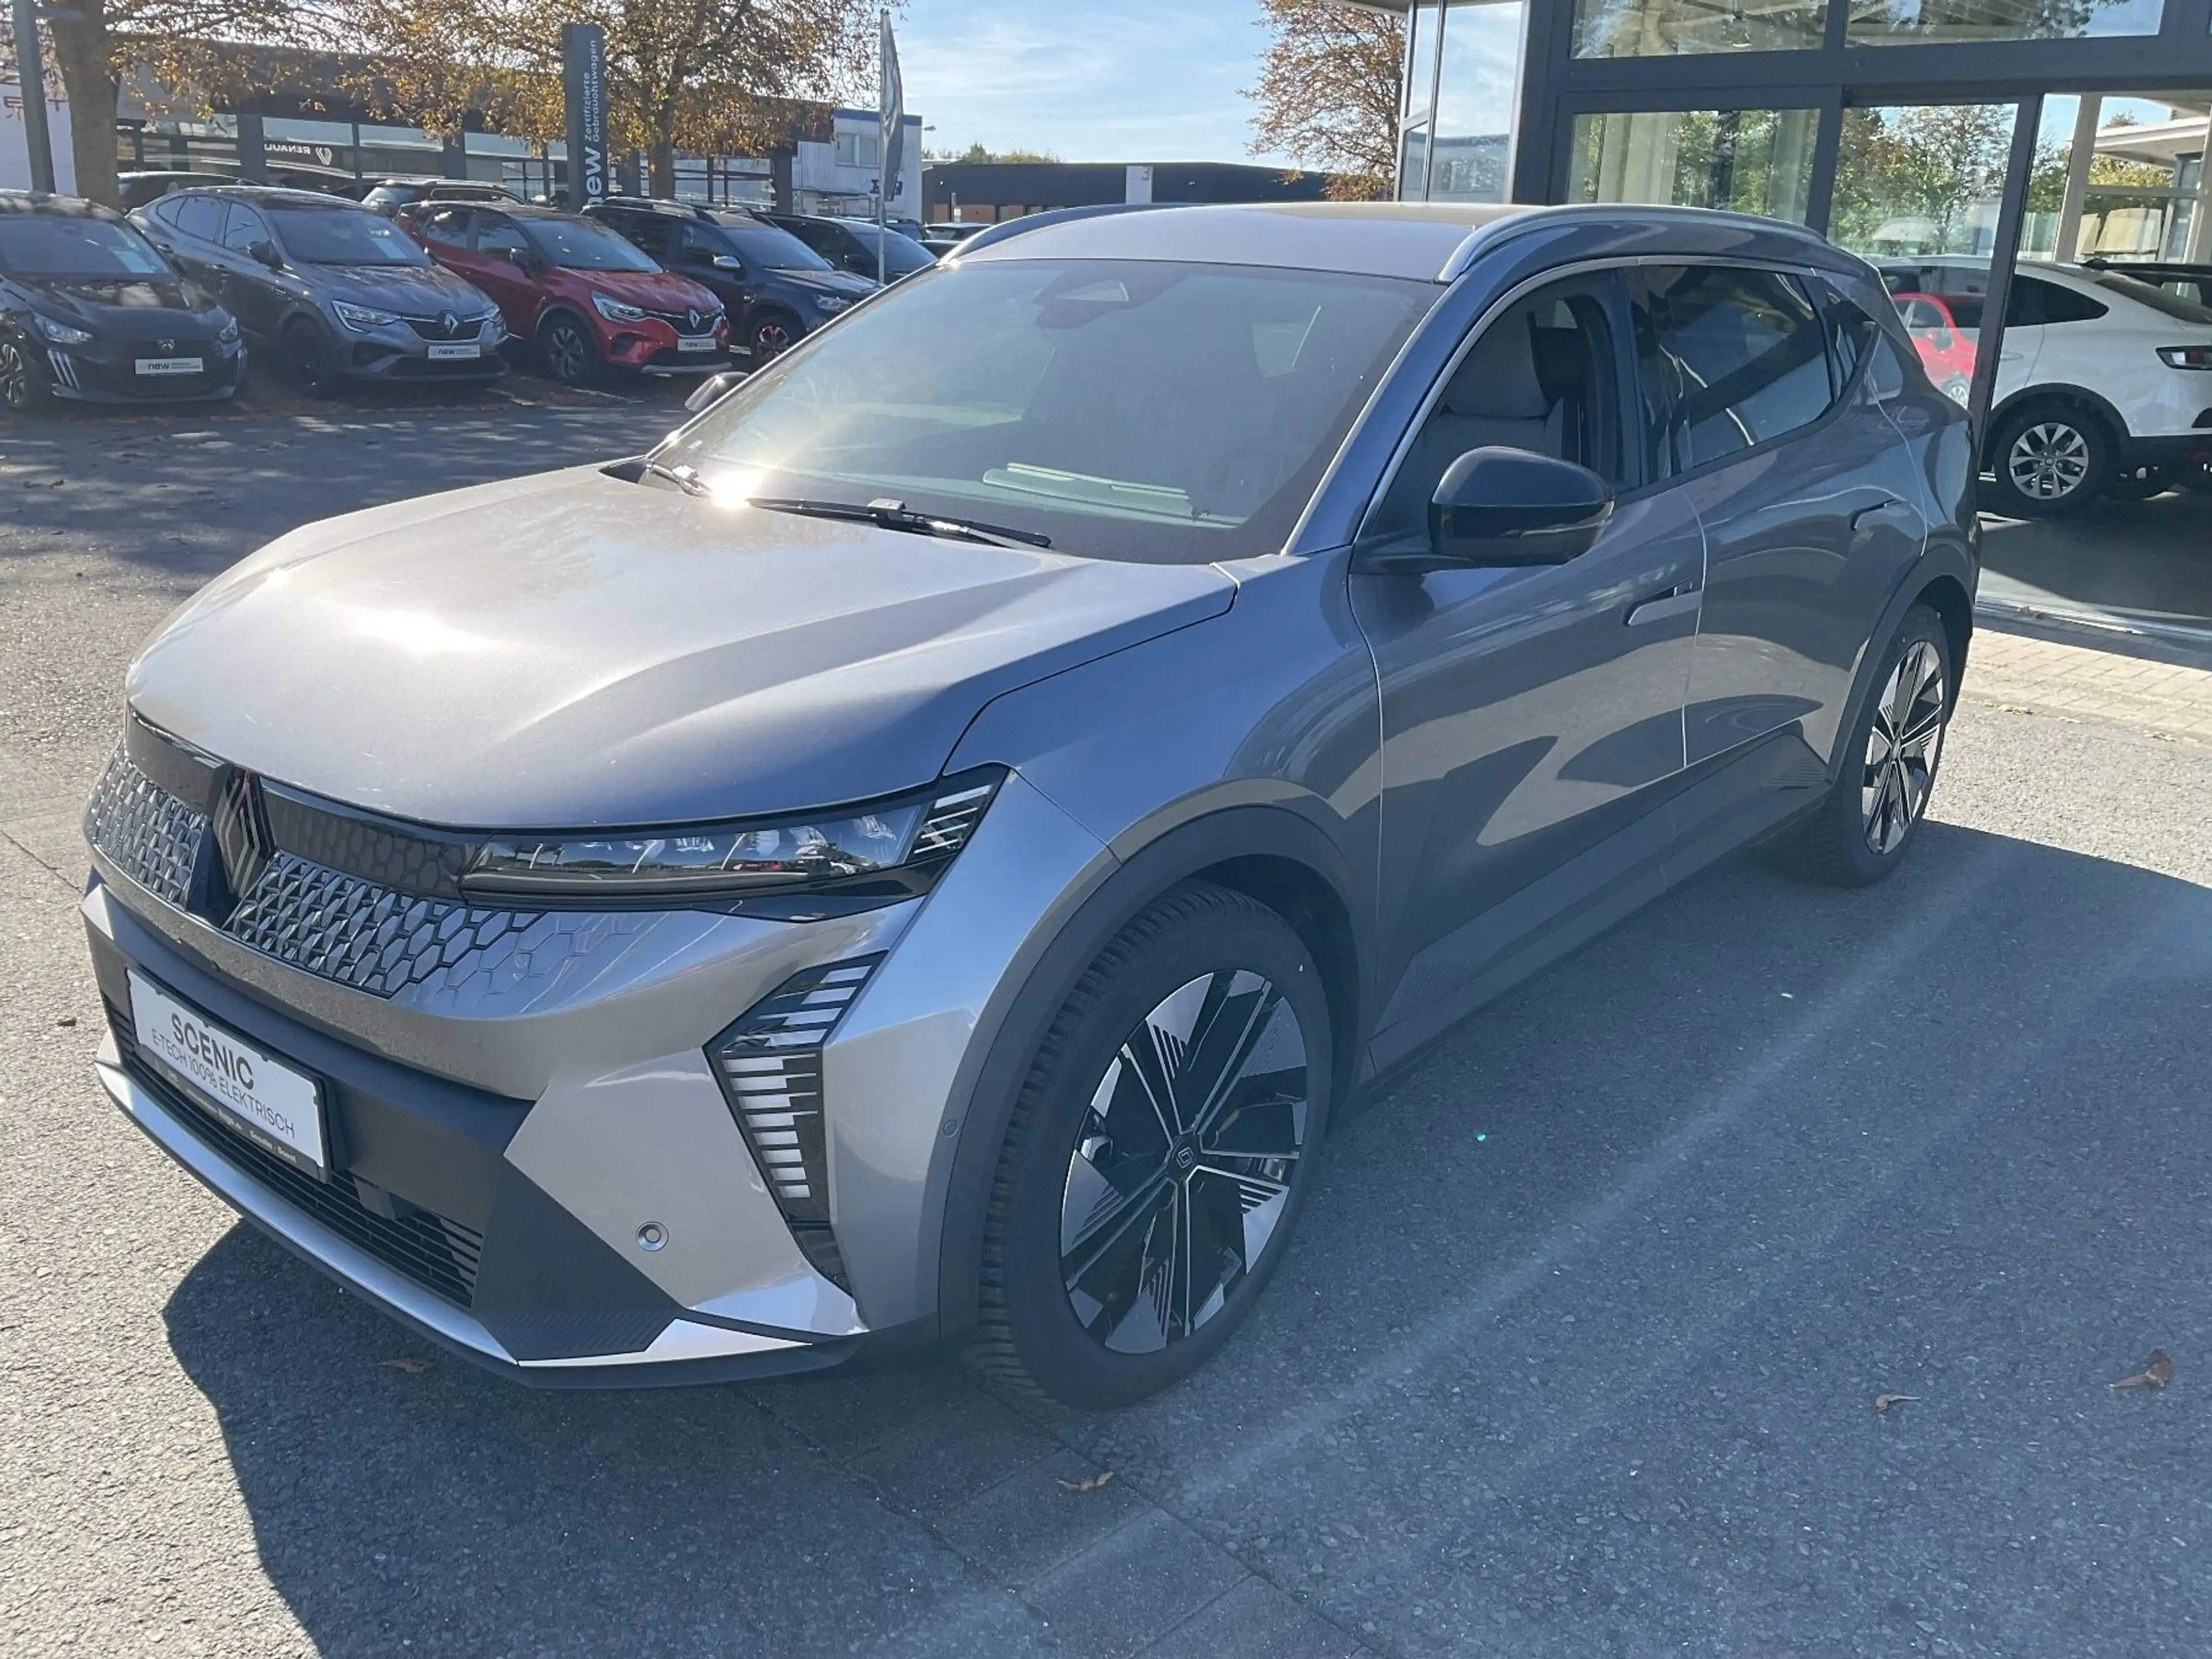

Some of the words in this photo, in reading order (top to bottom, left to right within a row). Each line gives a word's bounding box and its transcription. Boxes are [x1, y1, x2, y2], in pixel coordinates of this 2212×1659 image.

[151, 1027, 187, 1068] E-TECH
[218, 1075, 295, 1139] ELEKTRISCH
[171, 1012, 254, 1090] SCENIC
